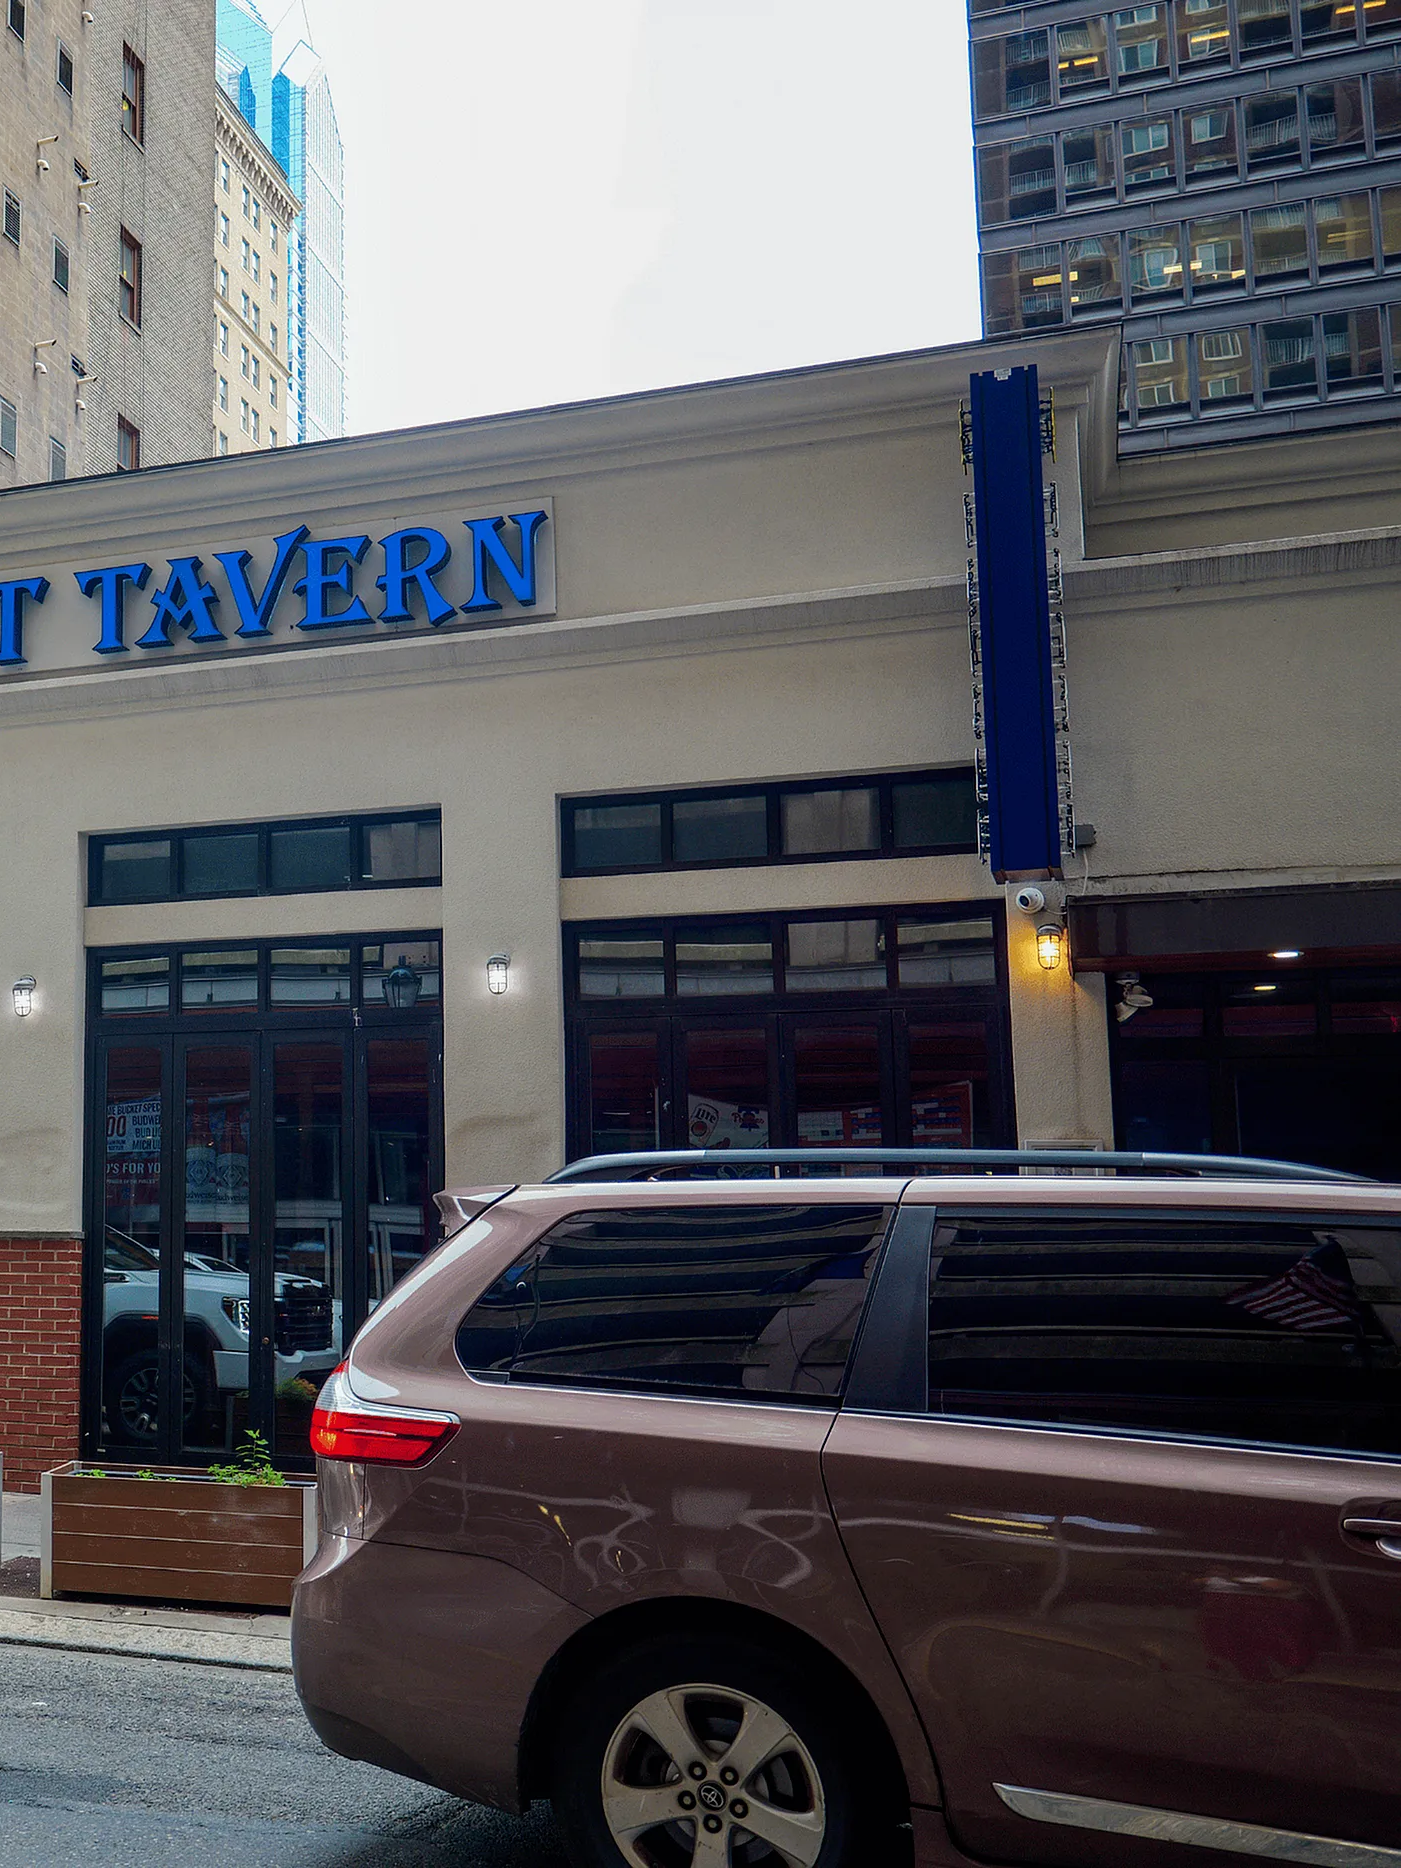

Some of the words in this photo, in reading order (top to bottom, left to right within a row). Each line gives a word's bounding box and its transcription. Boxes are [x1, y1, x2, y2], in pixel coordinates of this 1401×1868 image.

[73, 510, 549, 655] TAVERN
[117, 1103, 143, 1115] BUCKET
[122, 1162, 145, 1174] FOR
